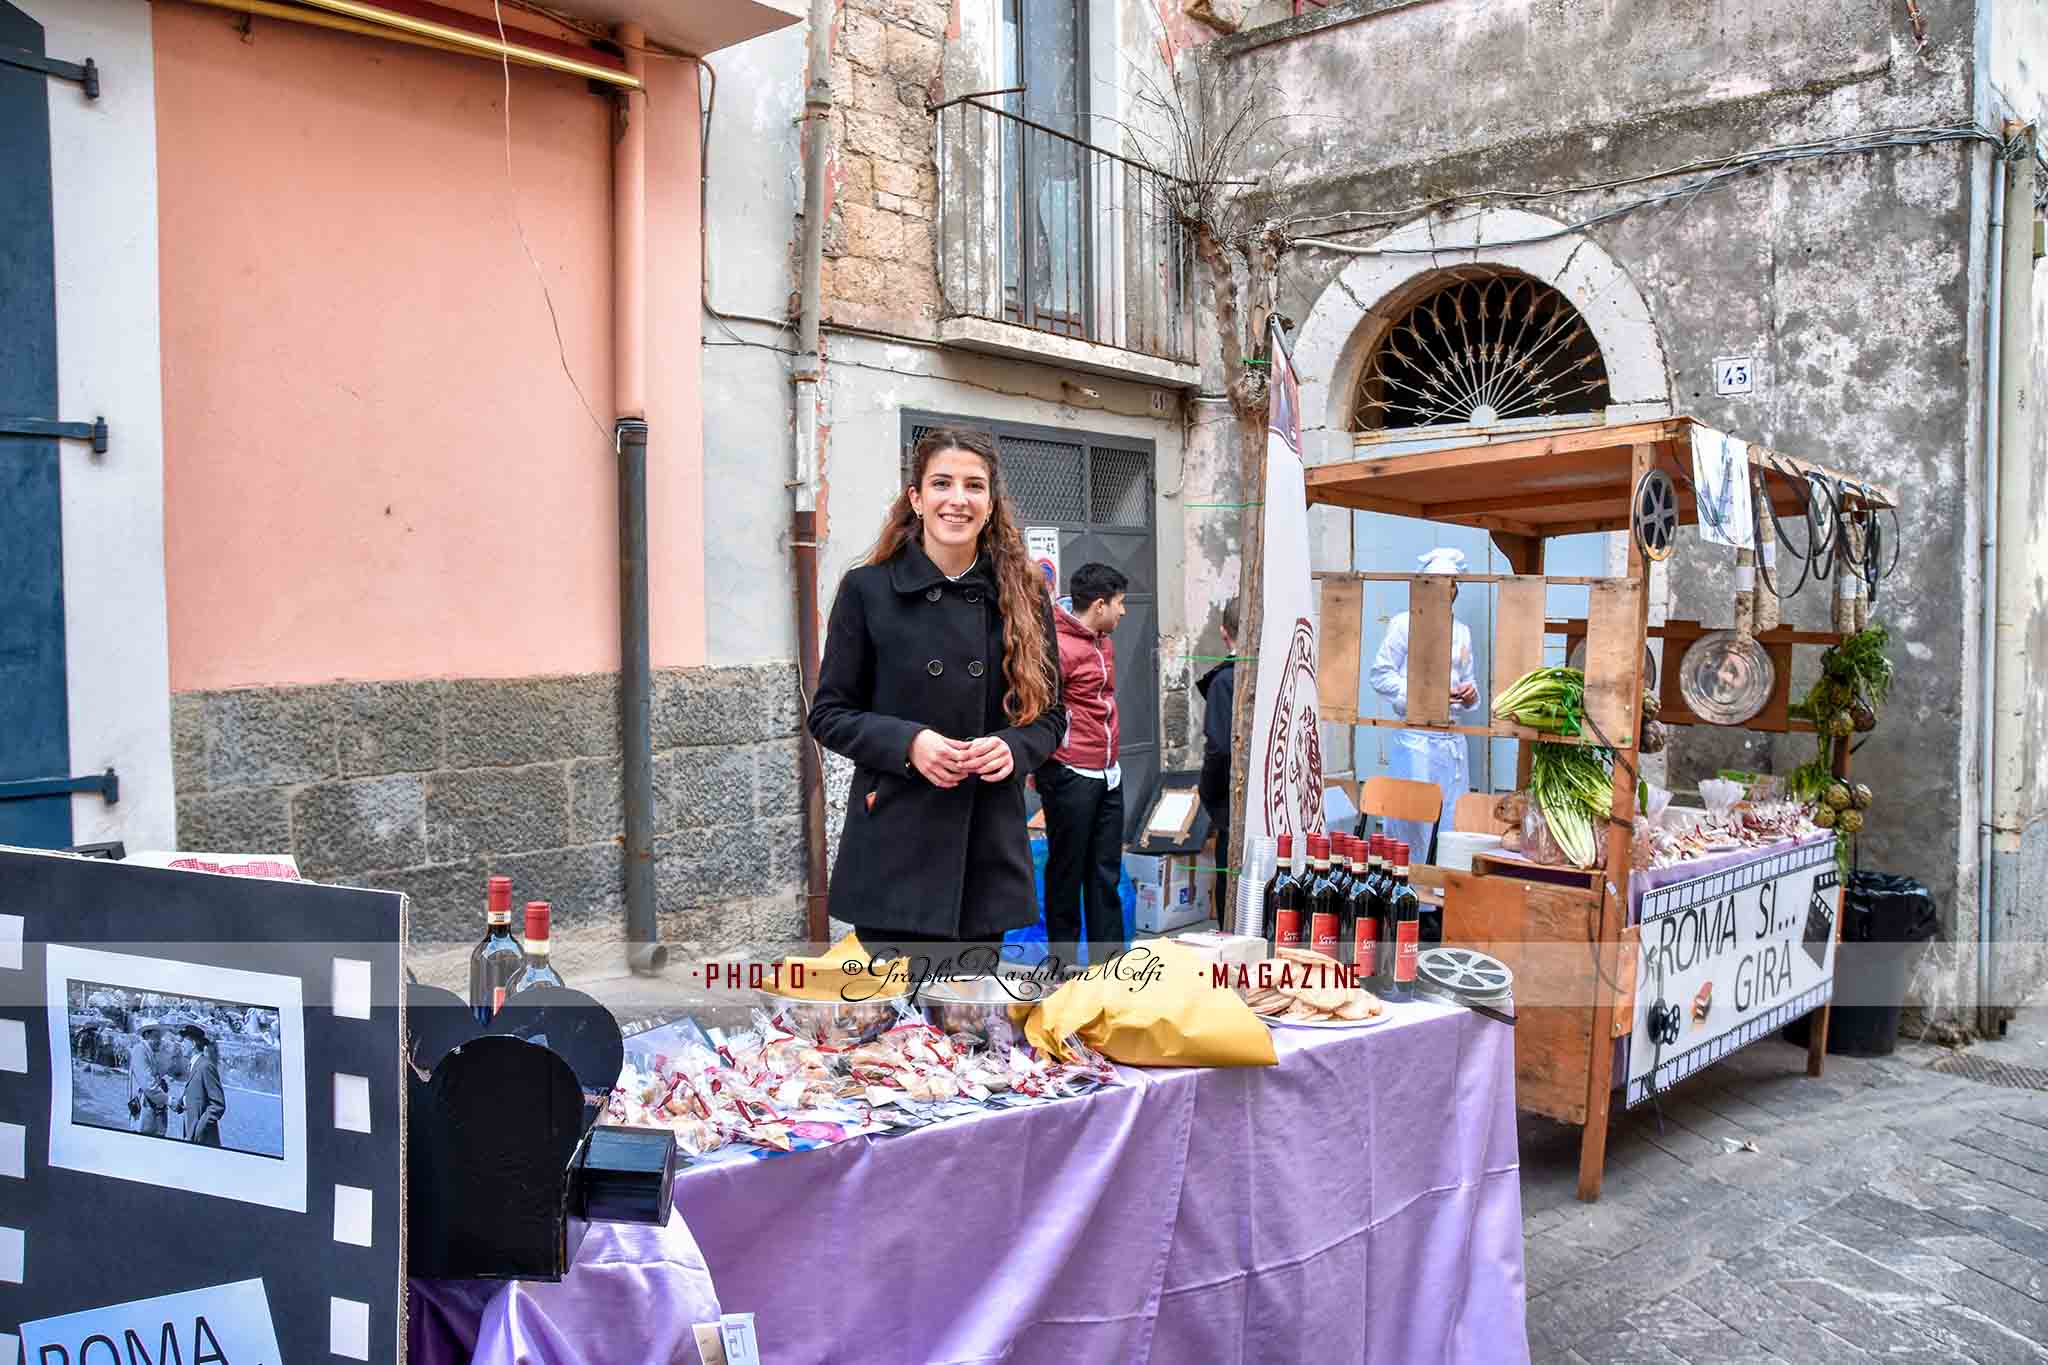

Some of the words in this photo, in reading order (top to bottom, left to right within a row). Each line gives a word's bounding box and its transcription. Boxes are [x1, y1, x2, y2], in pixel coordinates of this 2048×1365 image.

[1722, 366, 1747, 386] 43
[1274, 696, 1292, 811] RIONE
[1658, 895, 1737, 976] ROMA
[1755, 880, 1796, 940] SI...
[1734, 939, 1793, 1013] GIRA
